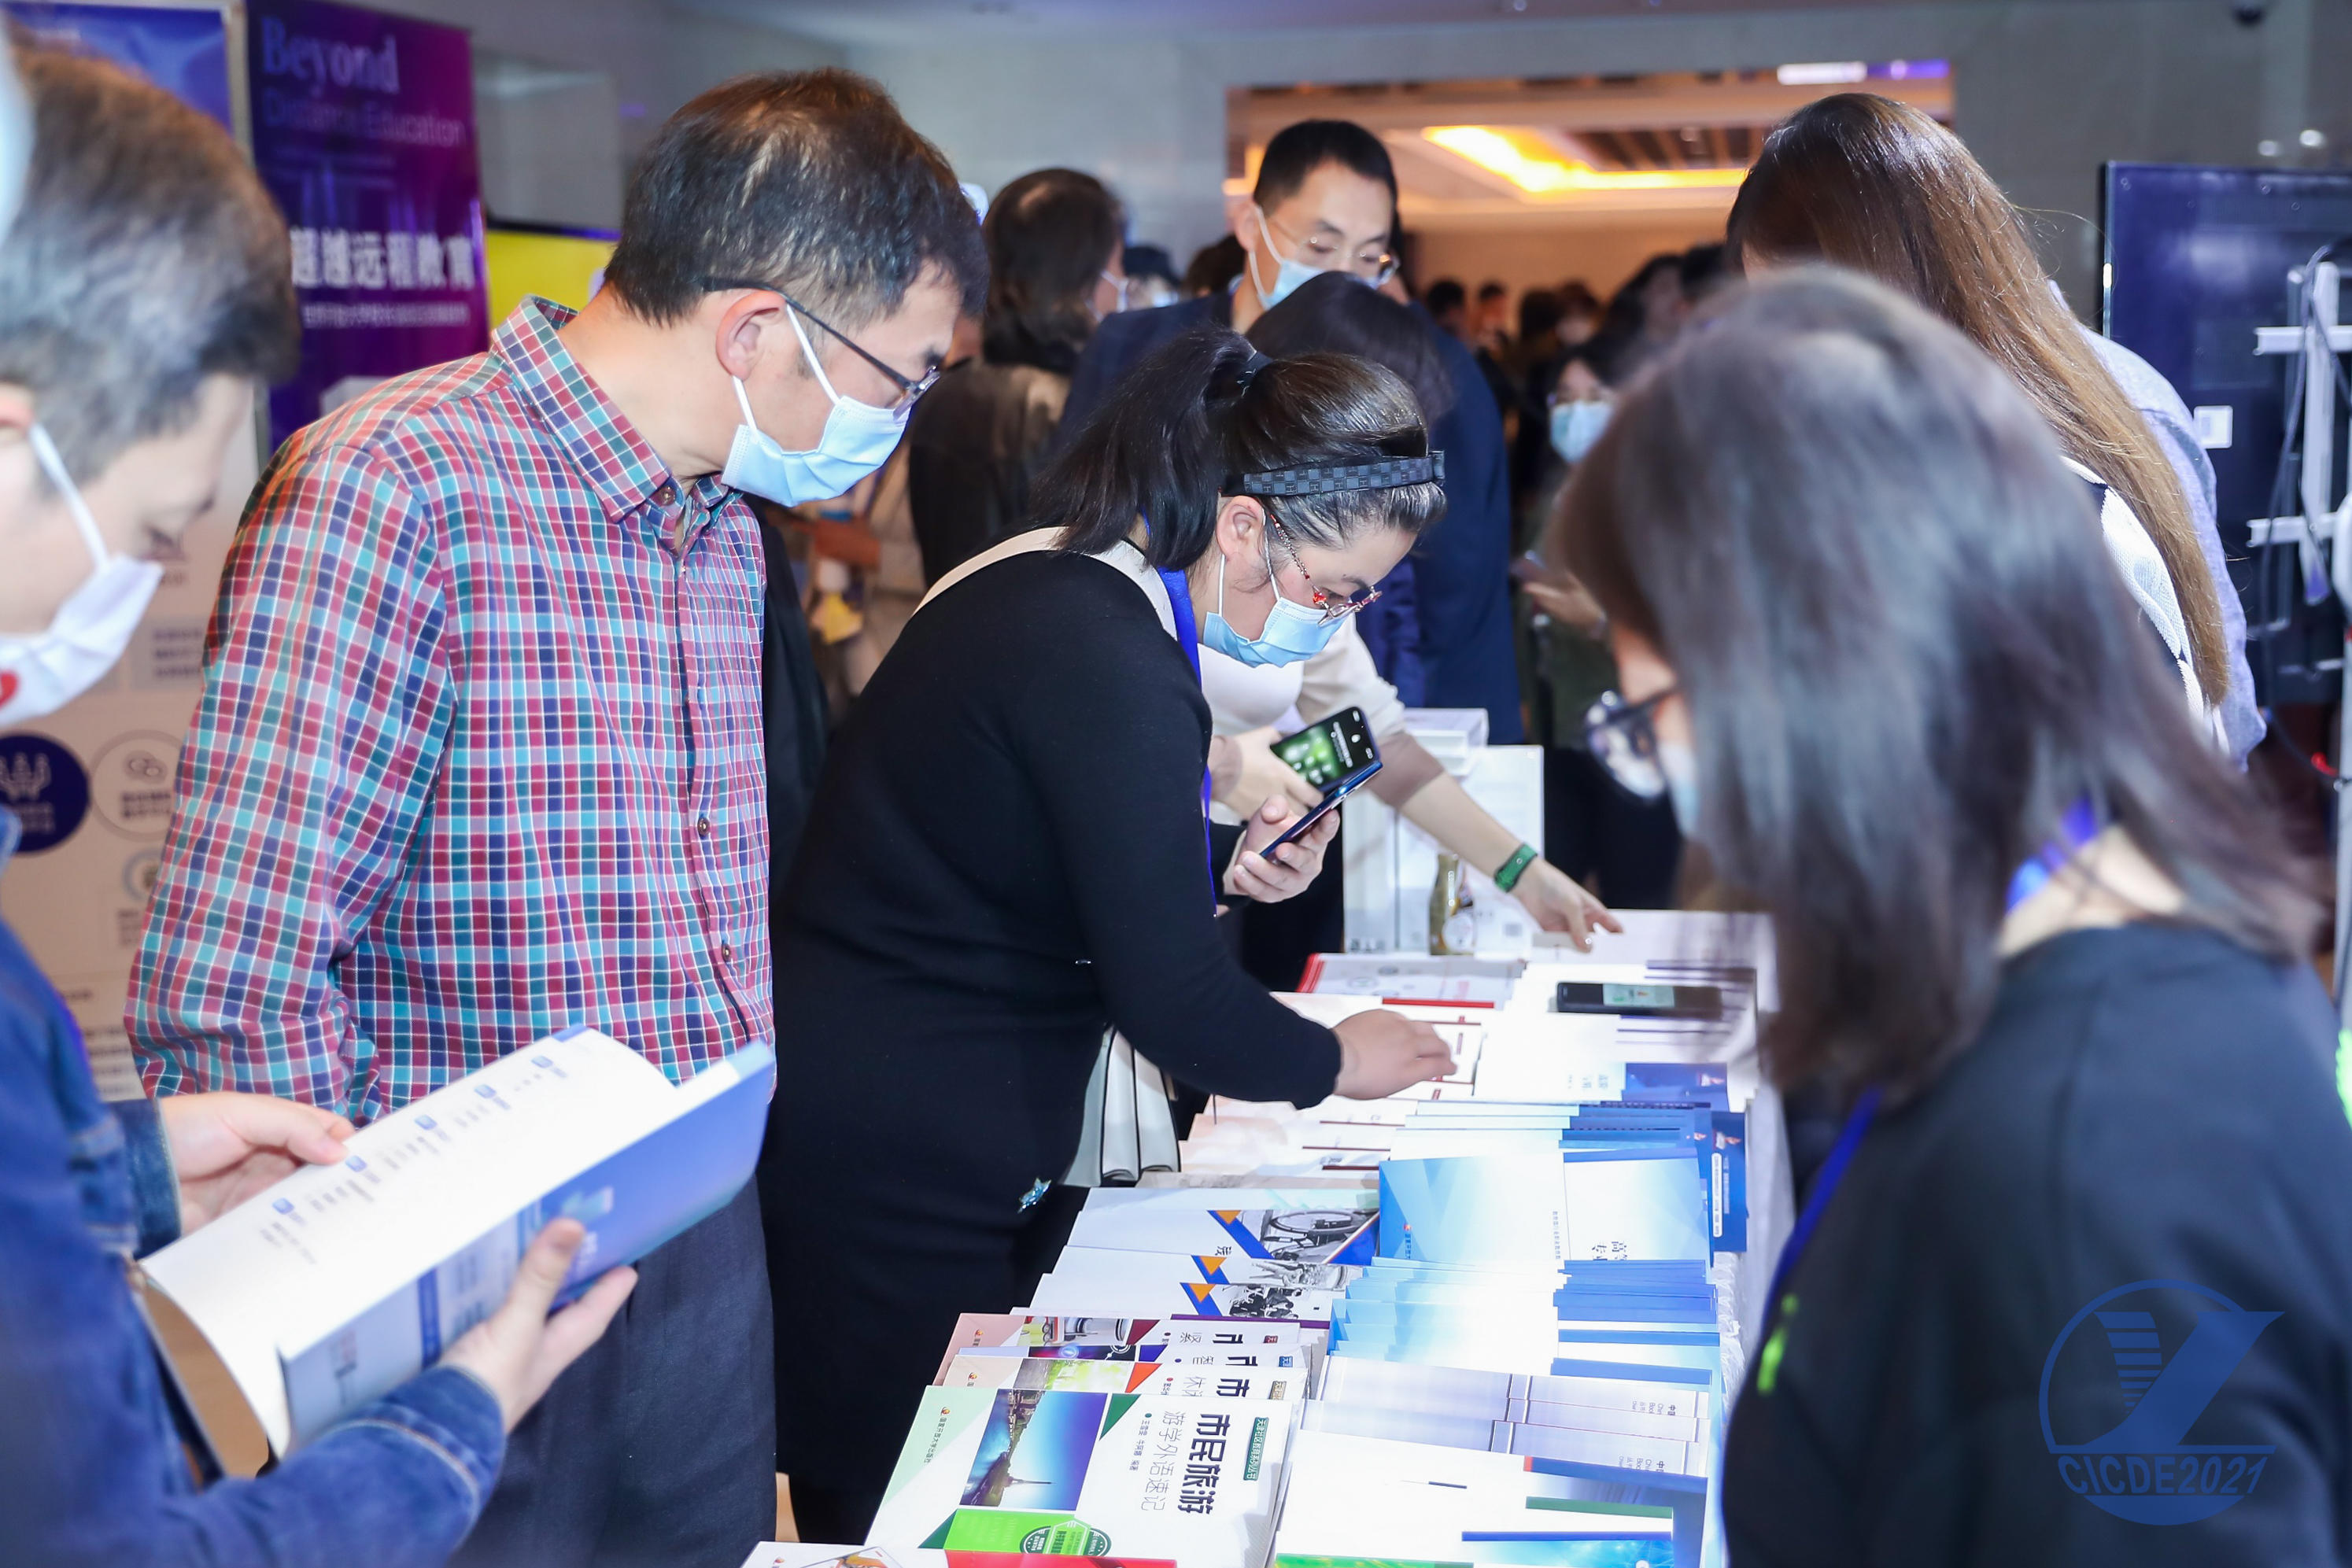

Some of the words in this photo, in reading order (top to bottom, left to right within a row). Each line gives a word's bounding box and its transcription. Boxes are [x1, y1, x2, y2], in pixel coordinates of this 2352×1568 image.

[261, 16, 400, 96] Beyond
[365, 101, 467, 147] Education
[1216, 1378, 1250, 1398] 市
[1141, 1411, 1187, 1511] 游学外语速记
[1177, 1413, 1231, 1515] 市民旅游
